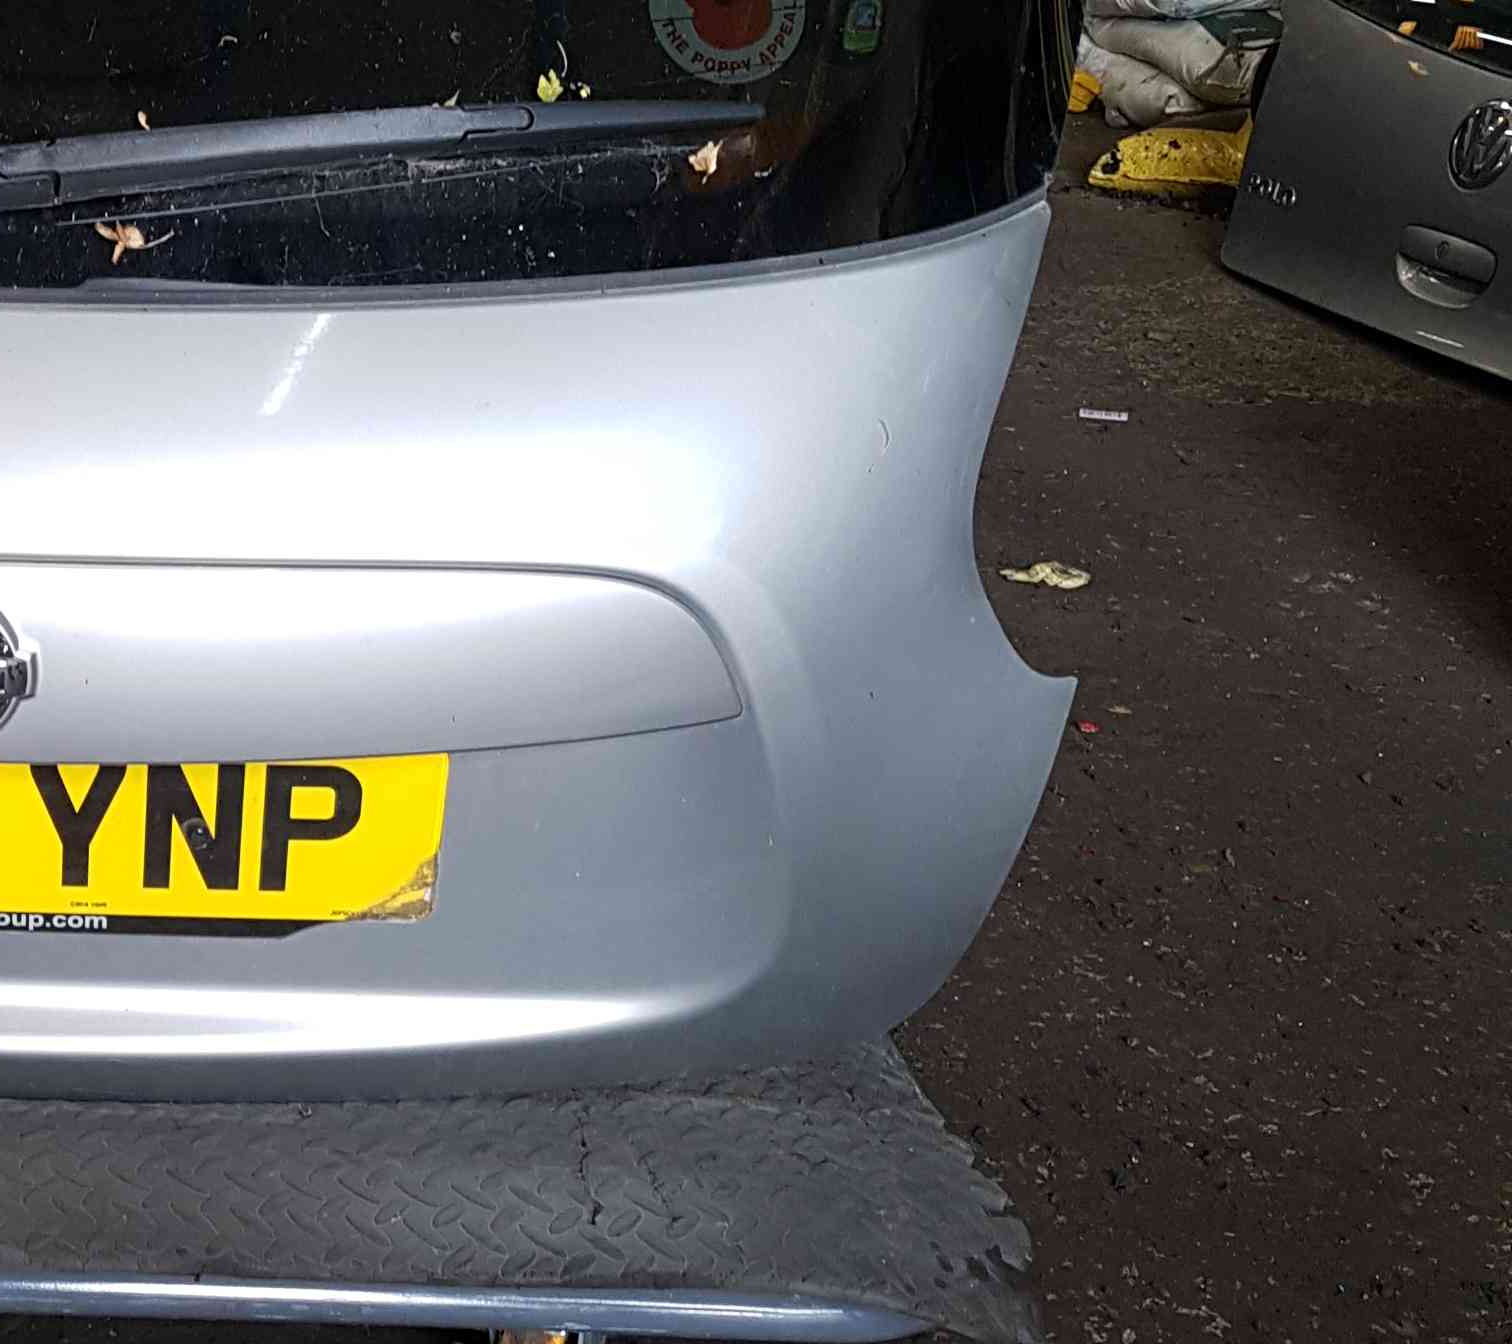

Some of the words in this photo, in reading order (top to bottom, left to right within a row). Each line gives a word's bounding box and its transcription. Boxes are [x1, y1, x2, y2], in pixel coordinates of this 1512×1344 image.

[662, 18, 689, 55] THE
[691, 51, 751, 75] POPPY
[759, 0, 798, 66] APPEAL
[29, 760, 363, 892] YNP
